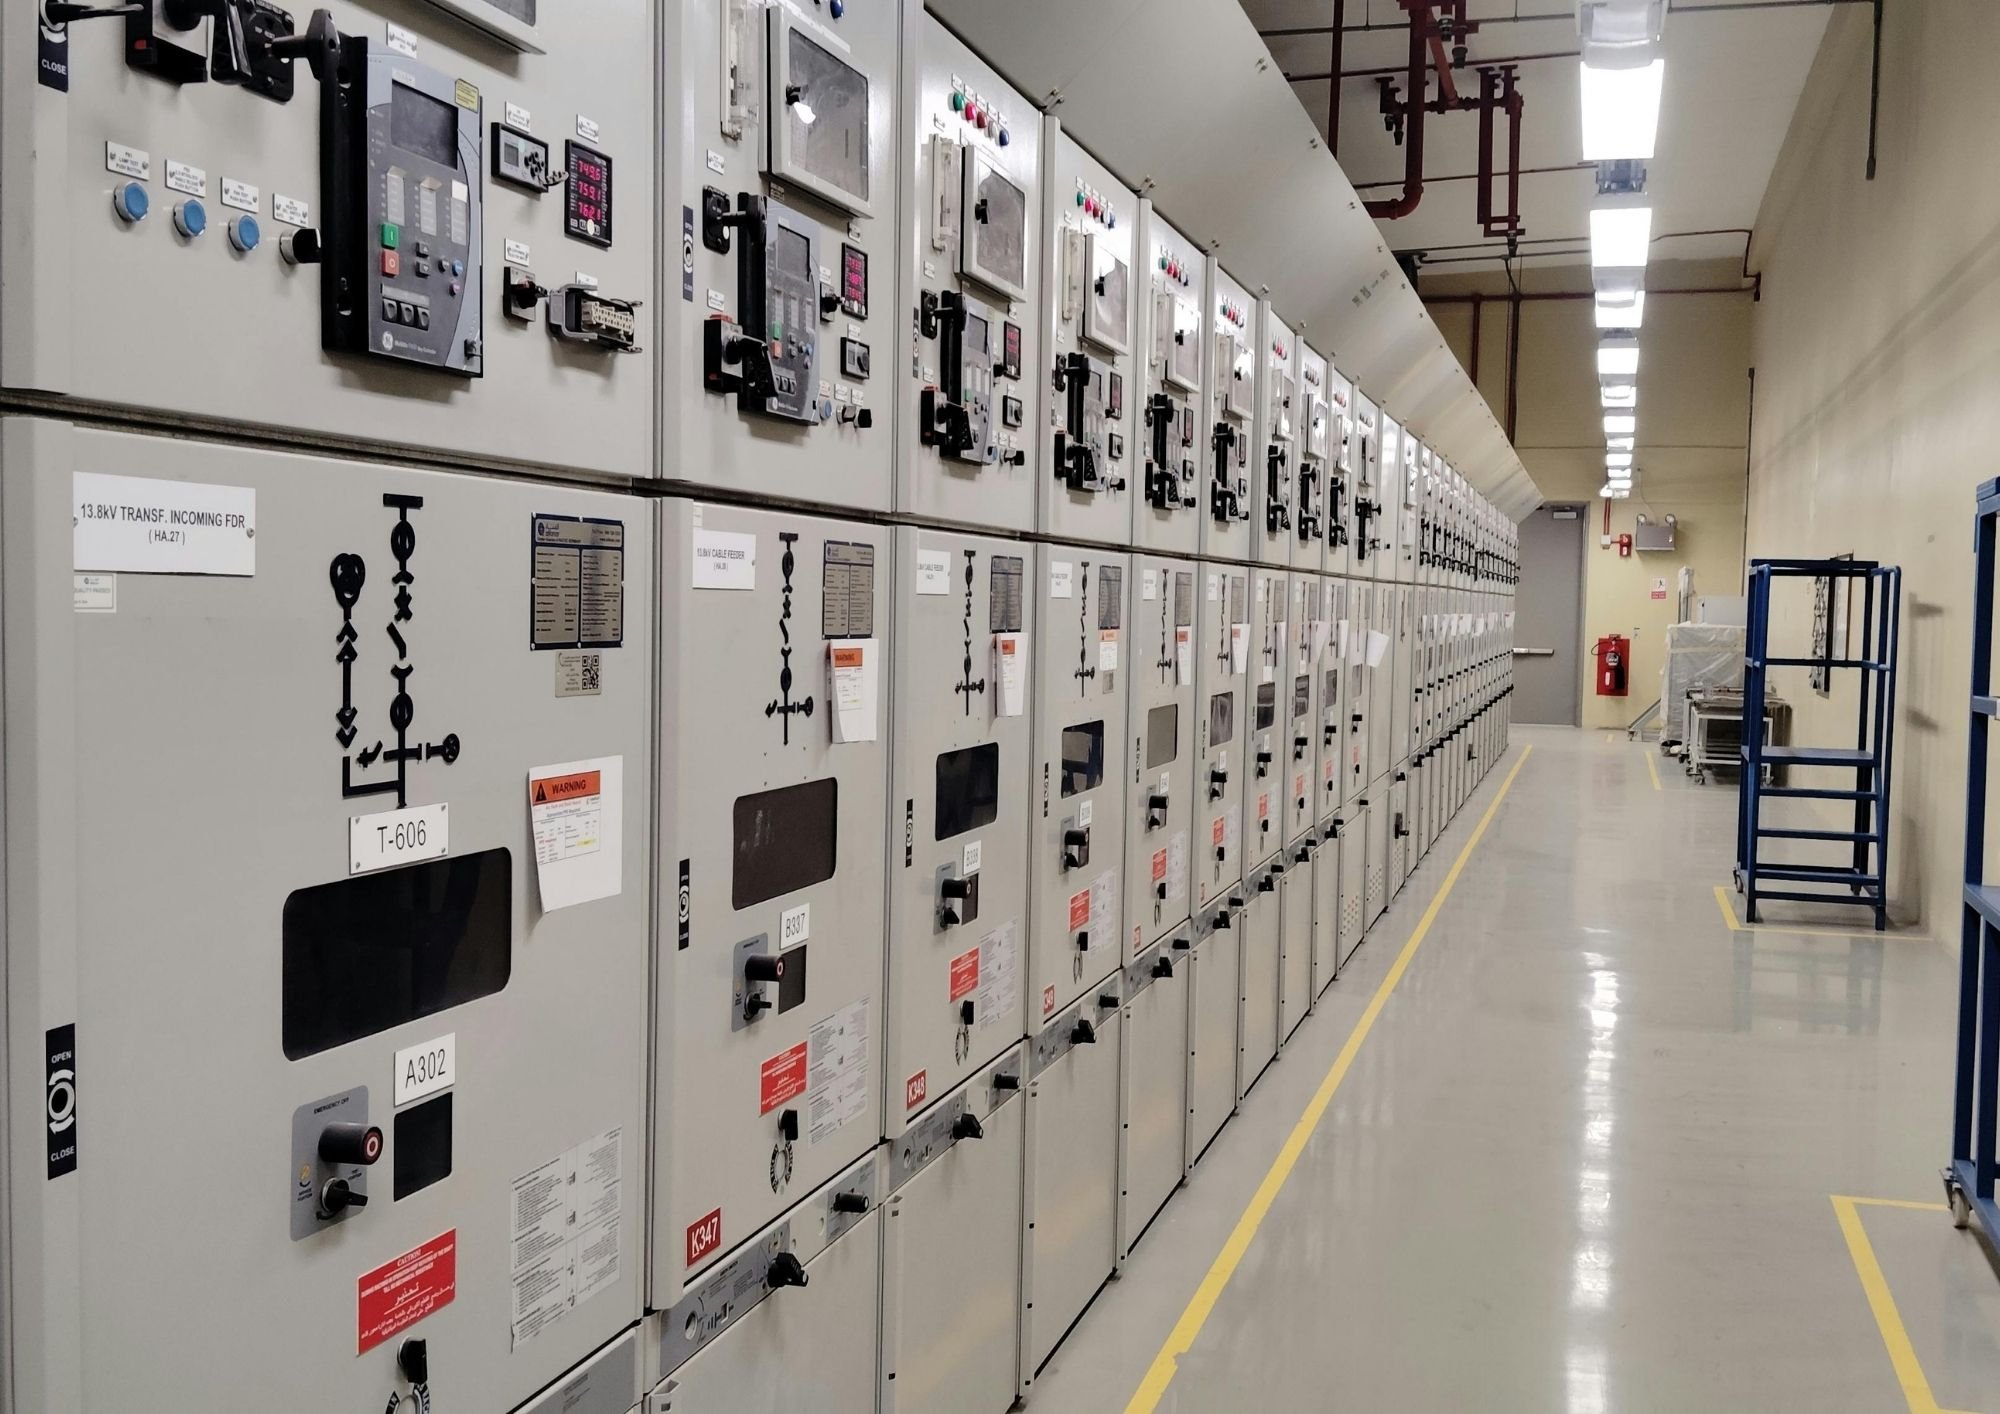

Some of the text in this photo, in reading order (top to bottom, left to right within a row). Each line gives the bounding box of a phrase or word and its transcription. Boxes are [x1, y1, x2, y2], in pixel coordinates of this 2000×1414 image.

[41, 58, 67, 76] CLOSE
[81, 503, 246, 529] 13.8kV TRANSF. INCOMING FDR
[154, 529, 180, 543] HA.27
[711, 548, 727, 559] CABLE
[727, 549, 745, 560] FEEDER
[552, 779, 587, 795] WARNING
[376, 819, 428, 854] T-606
[785, 912, 806, 938] B337
[51, 1050, 72, 1064] OPEN
[405, 1048, 447, 1089] A302
[313, 1096, 350, 1115] EMERGENCY OFF
[50, 1145, 76, 1162] CLOSE
[691, 1216, 718, 1259] K347
